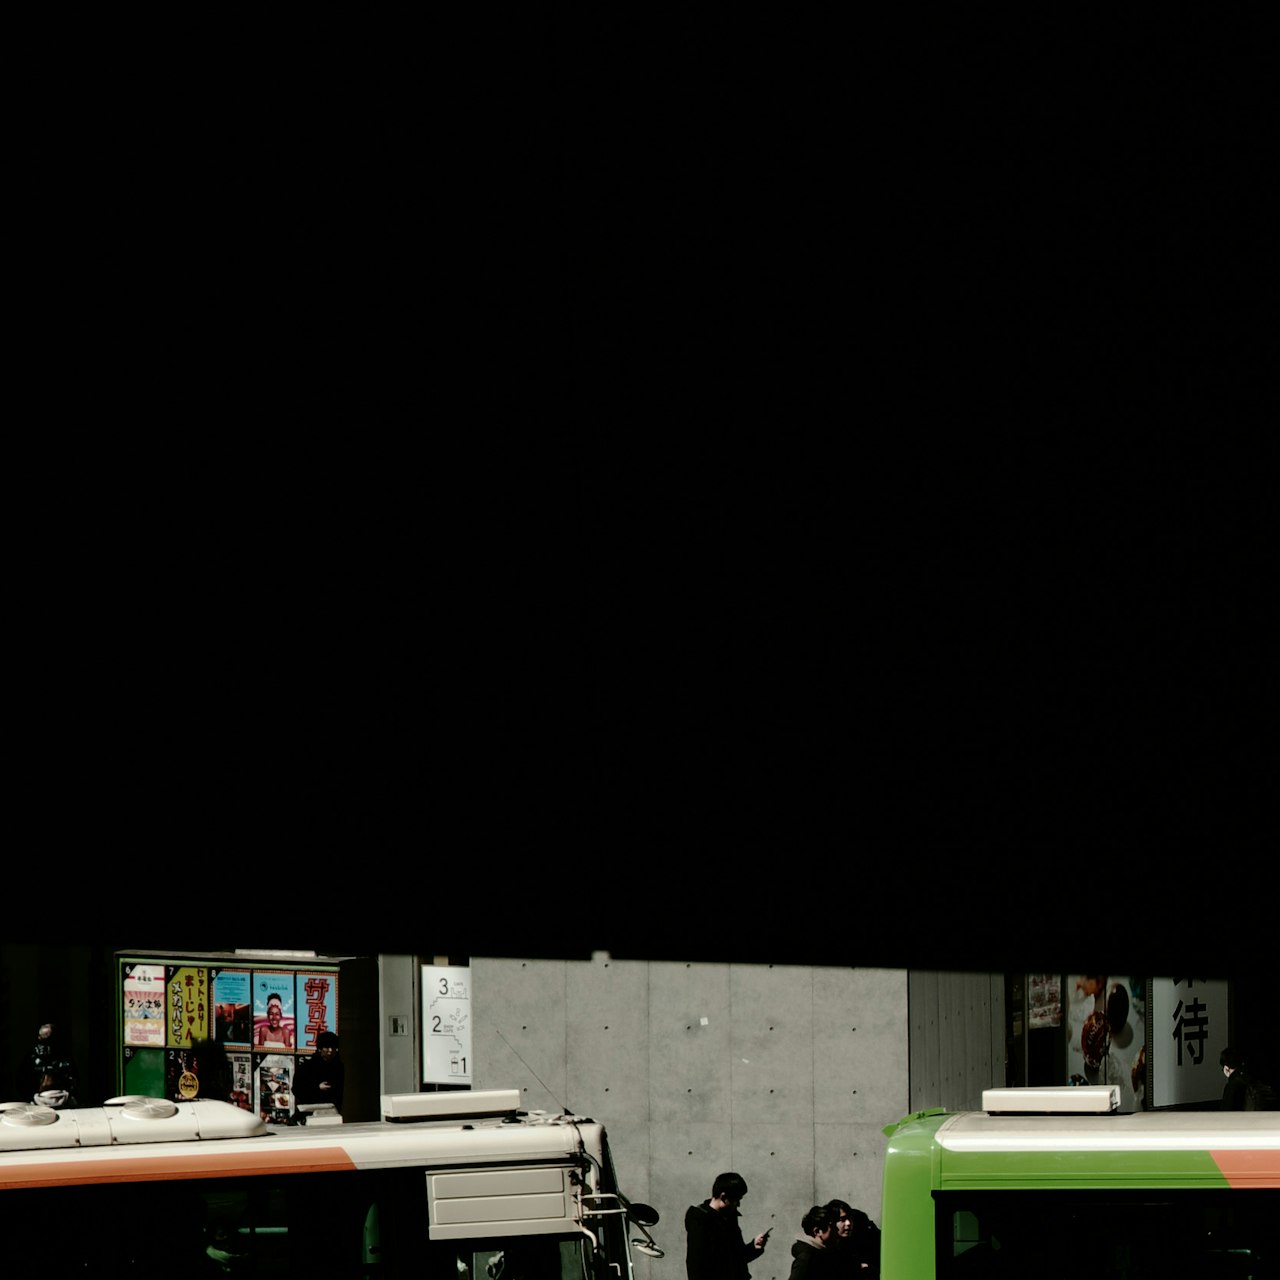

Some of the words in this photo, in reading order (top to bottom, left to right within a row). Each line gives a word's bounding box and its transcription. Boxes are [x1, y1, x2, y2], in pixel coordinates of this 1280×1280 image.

[439, 977, 449, 996] 3
[432, 1015, 442, 1033] 2
[460, 1057, 466, 1074] 1
